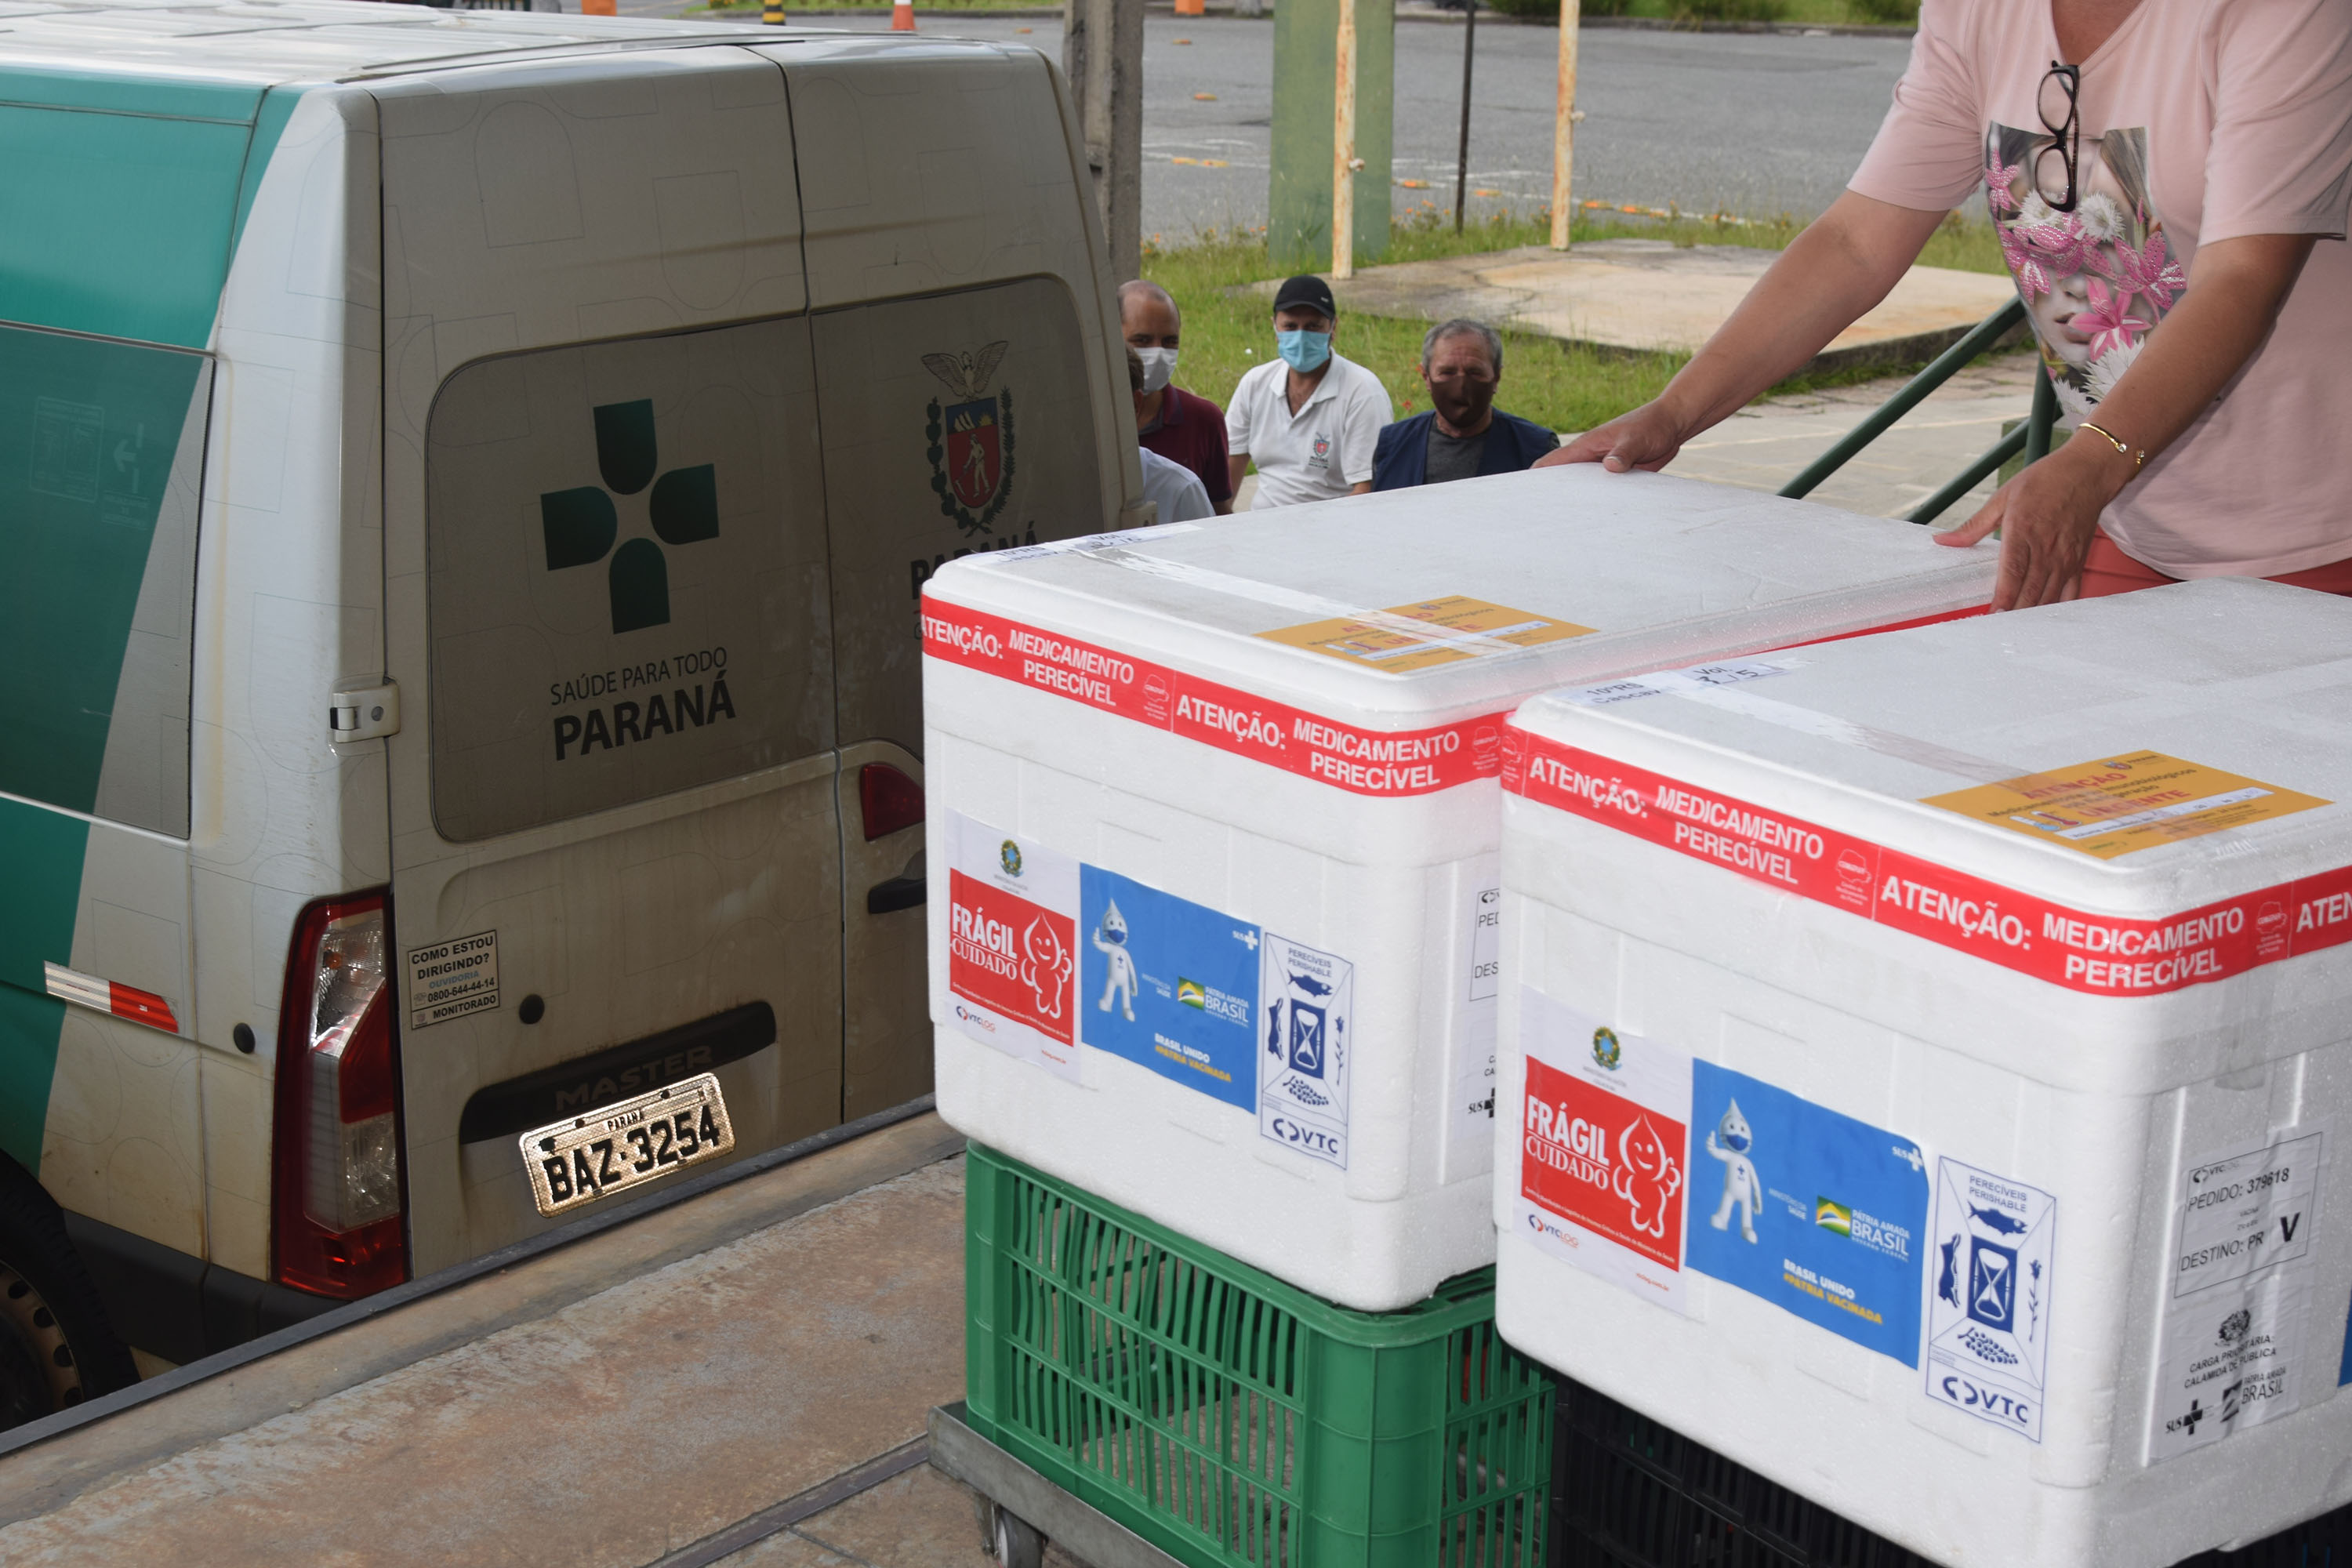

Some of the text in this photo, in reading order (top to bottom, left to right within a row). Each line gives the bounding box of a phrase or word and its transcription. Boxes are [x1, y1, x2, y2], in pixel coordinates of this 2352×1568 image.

[1008, 629, 1134, 684] MEDICAMENTO
[550, 647, 728, 706] SAÚDE PARA TODO
[1024, 659, 1116, 706] PERECÍVEL
[554, 670, 736, 761] PARANÁ
[1177, 695, 1286, 750] ATENÇÃO:
[1294, 718, 1460, 761] MEDICAMENTO
[1311, 751, 1440, 789] PERECÍVEL
[1530, 757, 1648, 818] ATENÇÃO:
[2020, 772, 2128, 800] ATENÇÃO
[2077, 789, 2191, 817] URGENTE
[1655, 785, 1824, 859] MEDICAMENTO
[1675, 822, 1798, 884] PERECÍVEL
[1881, 875, 2032, 950] ATENÇÃO:
[953, 902, 1018, 960] FRÁGIL
[2042, 907, 2244, 956] MEDICAMENTO
[412, 935, 493, 964] COMO ESTOU
[417, 953, 490, 980] DIRIGINDO?
[952, 938, 1017, 980] CUIDADO
[1288, 947, 1331, 968] PERECÍVEIS
[429, 971, 479, 989] OUVIDORIA
[2065, 948, 2223, 988] PERECÍVEL
[427, 977, 495, 1003] 0800-644-44-14
[433, 995, 496, 1019] MONITORADO
[1205, 995, 1249, 1023] BRASIL
[1154, 1033, 1210, 1063] BRASIL UNIDO
[556, 1046, 713, 1112] MASTER
[1301, 1127, 1338, 1154] VTC
[1528, 1094, 1610, 1165] FRÁGIL
[1526, 1136, 1608, 1190] CUIDADO
[1969, 1174, 2027, 1201] PERECÍVEIS
[1969, 1187, 2027, 1213] PERISHABLE
[2188, 1167, 2289, 1212] PEDIDO: 379618
[1852, 1220, 1908, 1256] BRASIL
[1853, 1210, 1910, 1239] PÁTRIA AMADA
[2280, 1212, 2301, 1243] V
[2181, 1231, 2264, 1272] DESTINO: PR
[1784, 1258, 1855, 1300] BRASIL UNIDO
[1828, 1292, 1883, 1325] VACINADA
[2189, 1355, 2220, 1373] CARGA
[2239, 1348, 2277, 1365] PÚBLICA
[1980, 1388, 2028, 1424] VTC
[2241, 1377, 2283, 1405] BRASIL
[2165, 1416, 2183, 1433] SUS
